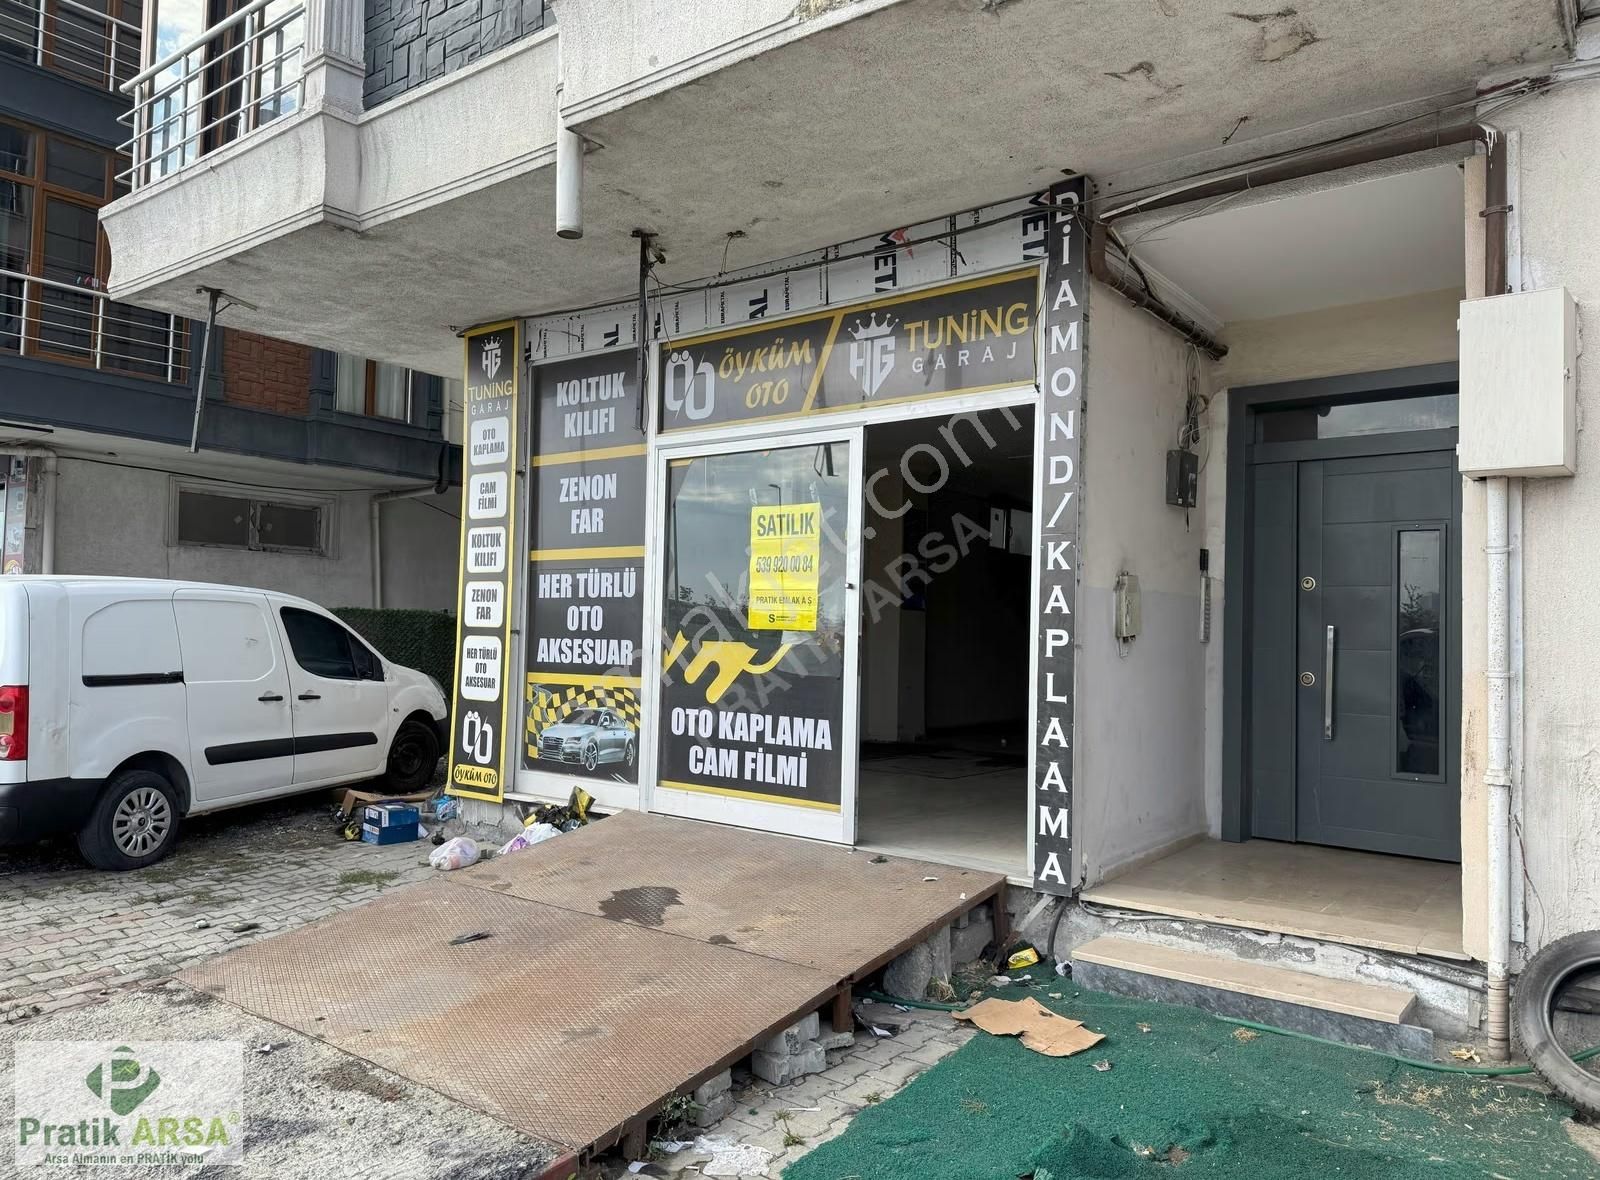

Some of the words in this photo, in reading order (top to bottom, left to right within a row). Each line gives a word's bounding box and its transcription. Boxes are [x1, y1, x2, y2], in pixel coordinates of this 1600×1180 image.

[911, 341, 1017, 373] GARAJ
[556, 371, 626, 407] KOLTUK
[745, 378, 789, 409] OTO
[471, 400, 509, 415] GARAJ
[564, 407, 616, 438] KILIFI
[482, 428, 496, 440] OTO
[473, 441, 505, 456] KAPLAMA
[479, 481, 496, 495] CAM
[559, 473, 617, 503] ZENON
[478, 495, 497, 510] FİLMİ
[570, 507, 604, 534] FAR
[757, 512, 814, 537] SATILIK
[471, 533, 501, 548] KOLTUK
[474, 552, 497, 566] KILIFI
[756, 556, 771, 573] 539
[773, 555, 788, 573] 920
[790, 555, 800, 572] 00
[802, 555, 813, 572] 84
[538, 572, 573, 598] HER
[576, 567, 636, 598] TÜRLÜ
[471, 589, 497, 602] ZENON
[476, 606, 491, 620] FAR
[566, 605, 603, 632] OTO
[466, 648, 478, 659] HER
[537, 638, 634, 666] AKSESUAR
[475, 662, 487, 674] OTO
[465, 676, 496, 689] AKSESUAR
[671, 707, 713, 738] OTO
[718, 710, 832, 751] KAPLAMA
[688, 745, 739, 779] CAM
[744, 747, 808, 788] FİLMİ
[483, 773, 497, 784] OTO
